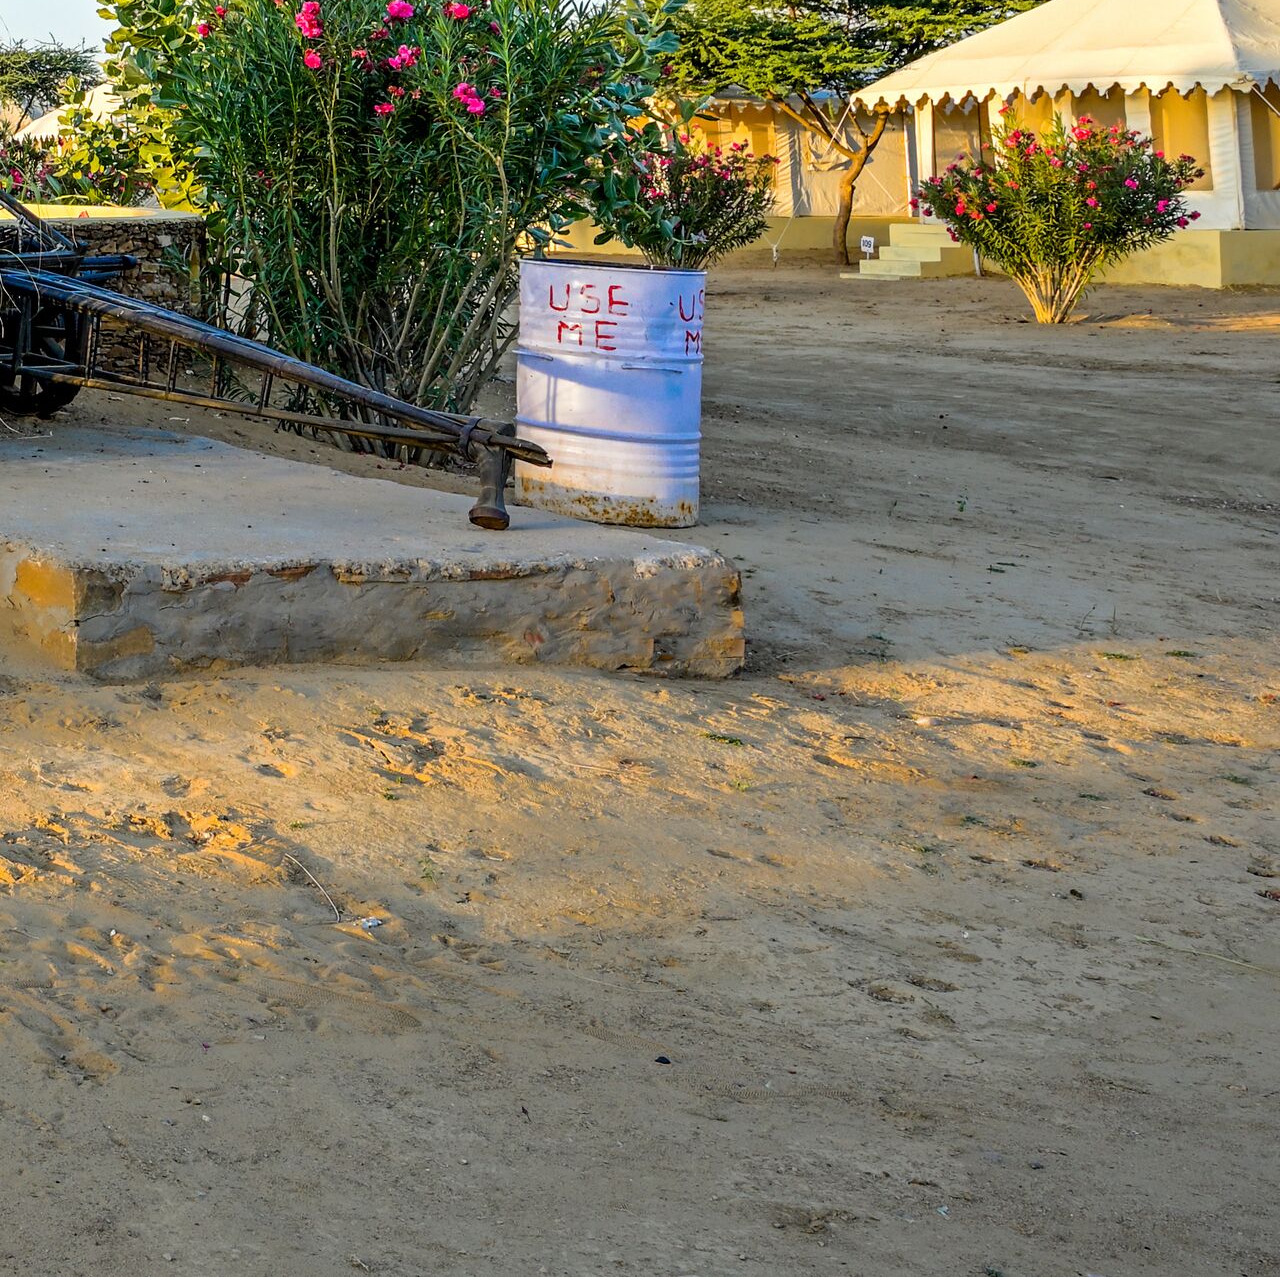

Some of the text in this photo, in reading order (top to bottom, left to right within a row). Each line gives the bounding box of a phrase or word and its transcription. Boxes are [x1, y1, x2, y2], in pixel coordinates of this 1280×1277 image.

[549, 284, 629, 316] USE
[557, 320, 618, 351] ME
[685, 329, 703, 357] M
